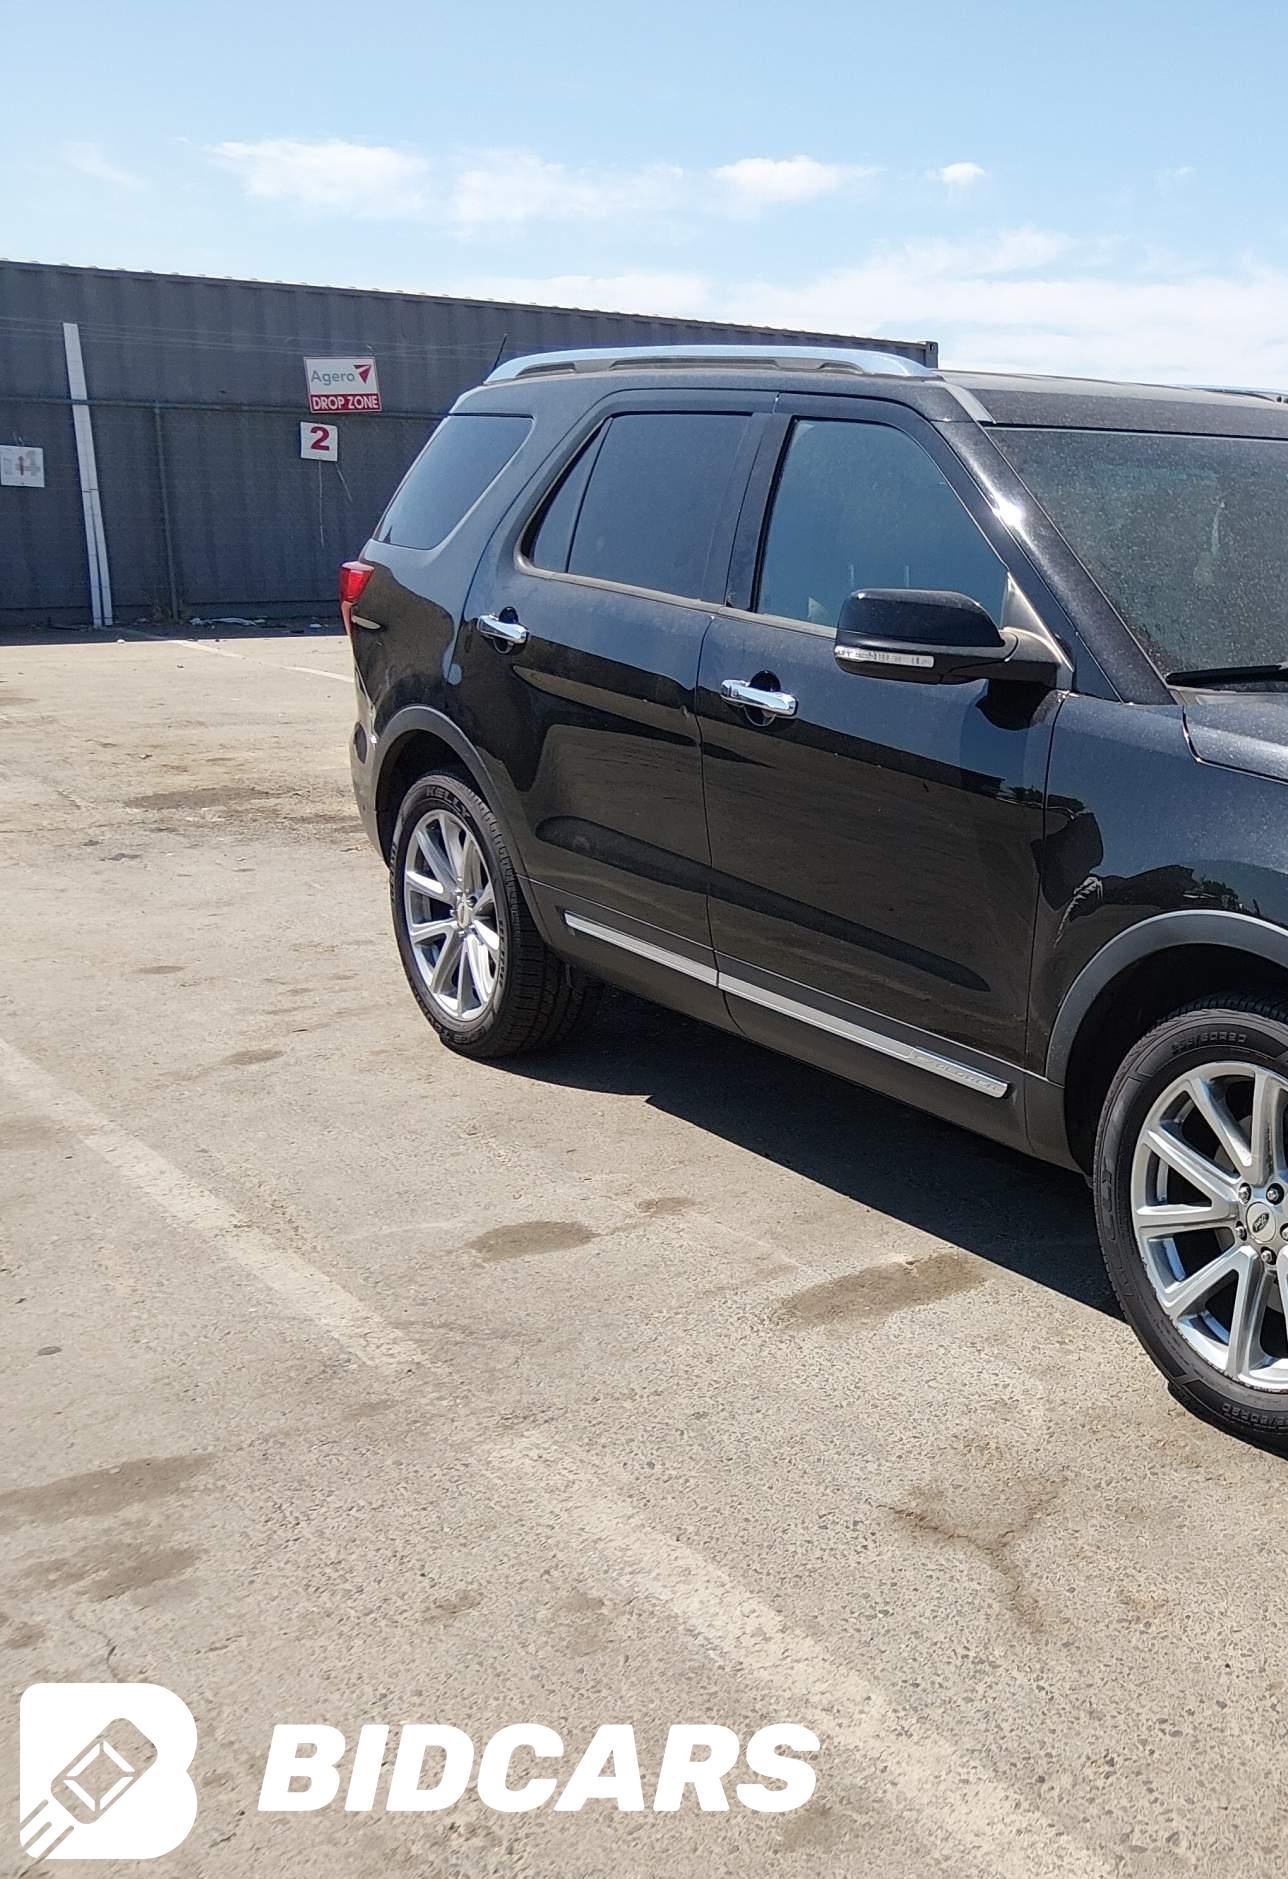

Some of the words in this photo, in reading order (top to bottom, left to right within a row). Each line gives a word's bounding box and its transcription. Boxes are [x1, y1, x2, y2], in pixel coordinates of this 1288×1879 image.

[311, 370, 355, 386] Agero
[312, 396, 345, 410] DROP
[347, 395, 379, 409] ZONE
[310, 426, 330, 451] 2
